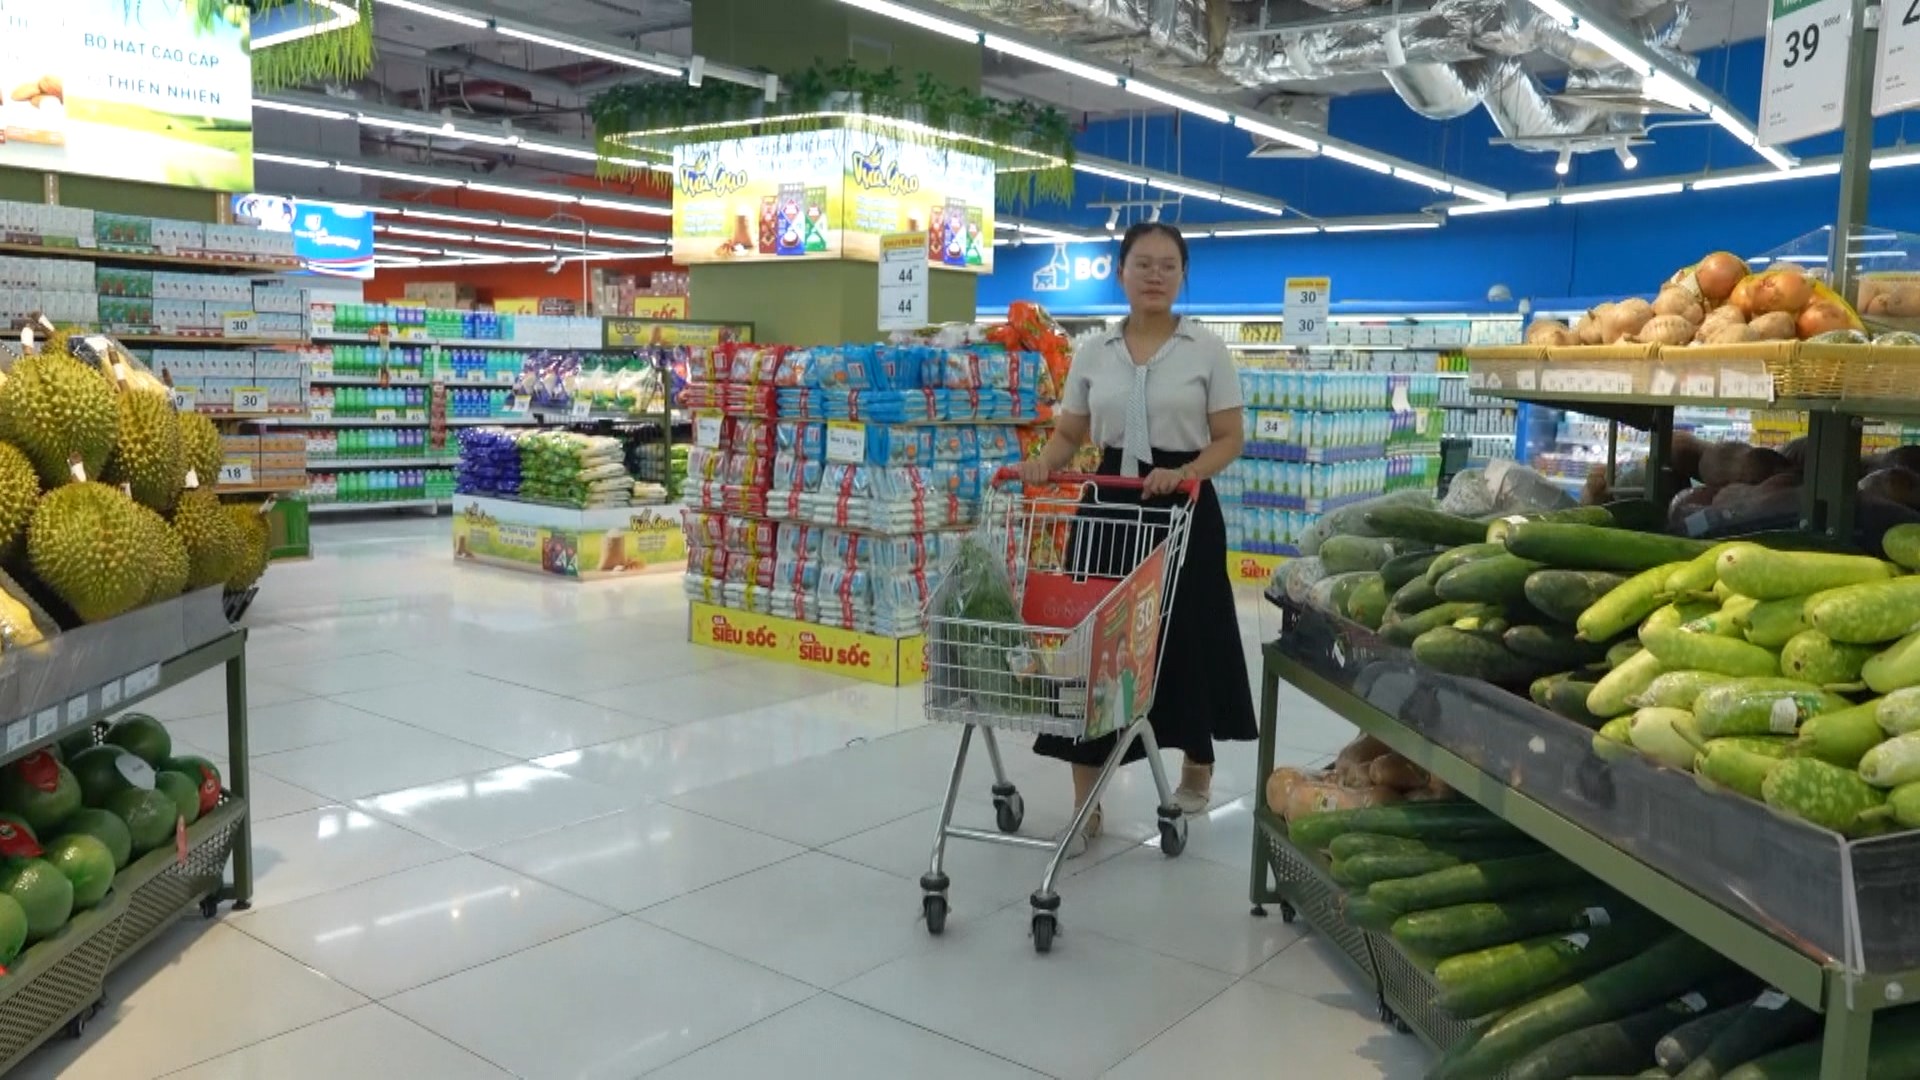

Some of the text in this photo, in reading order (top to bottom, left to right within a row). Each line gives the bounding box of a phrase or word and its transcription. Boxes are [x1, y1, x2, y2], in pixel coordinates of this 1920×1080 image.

[1783, 24, 1820, 68] 39
[898, 268, 913, 282] 44
[1300, 291, 1316, 304] 30
[898, 299, 912, 313] 44
[232, 321, 248, 331] 30
[1299, 319, 1314, 332] 30
[242, 396, 257, 406] 30
[1264, 421, 1278, 432] 34
[227, 469, 241, 479] 18
[1136, 597, 1155, 632] 30
[746, 625, 777, 648] SỐC
[837, 643, 871, 668] SỐC
